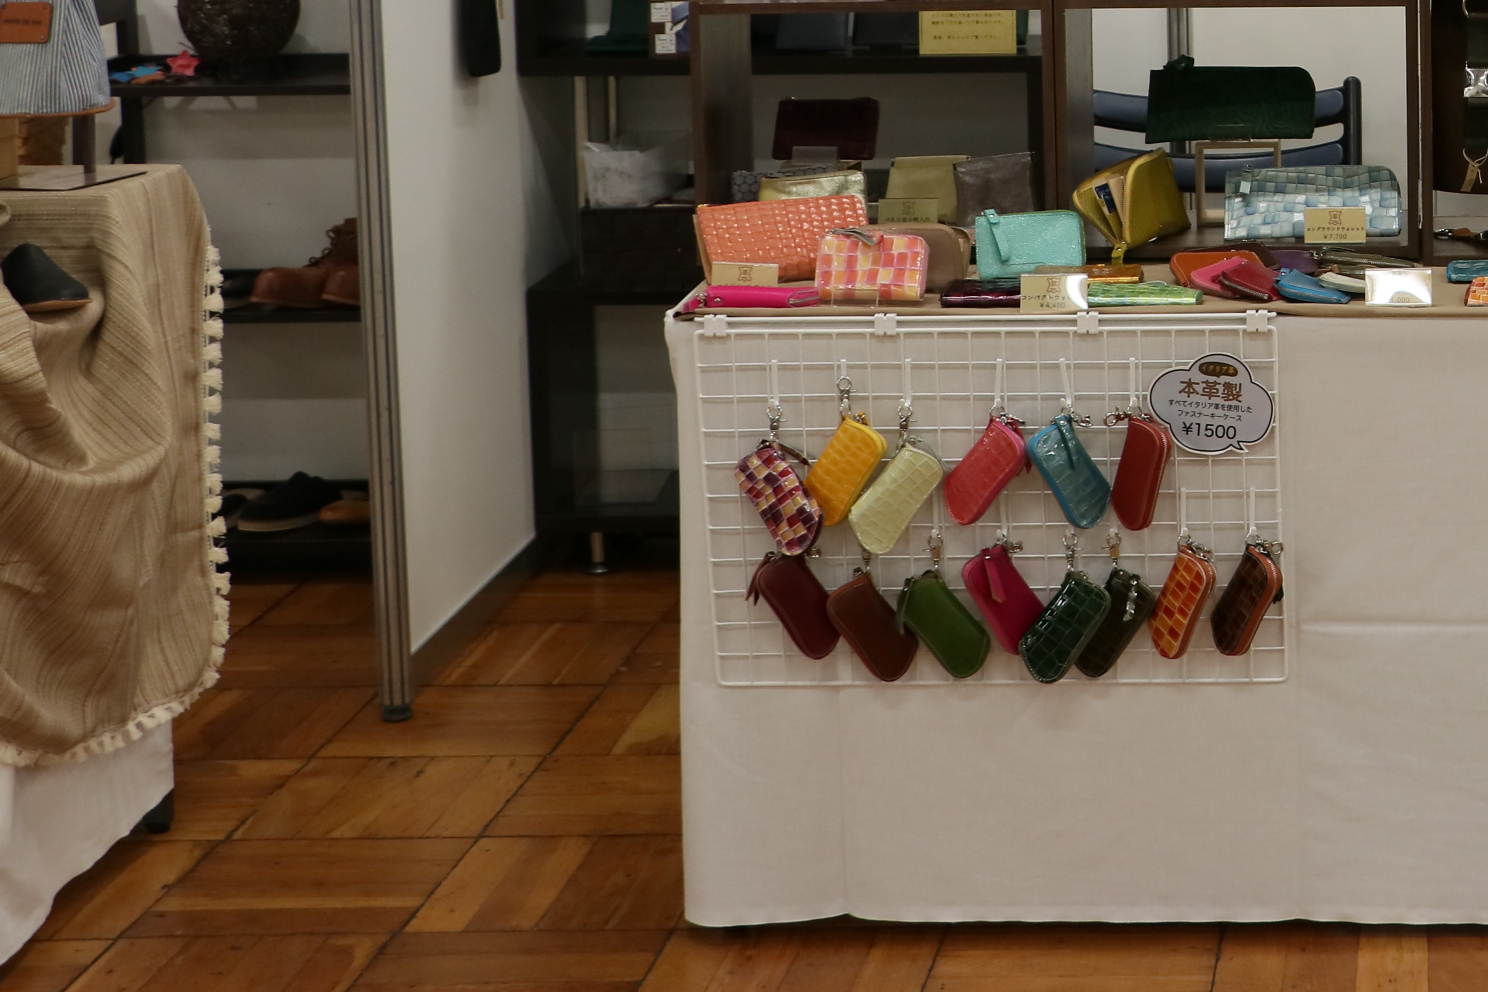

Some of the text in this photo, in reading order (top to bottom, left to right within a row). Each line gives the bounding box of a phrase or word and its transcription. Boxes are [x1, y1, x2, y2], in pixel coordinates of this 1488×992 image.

[1202, 364, 1236, 374] イタリア革
[1179, 378, 1242, 402] 本革製
[1168, 399, 1253, 413] すべてイタリア革を使用した
[1178, 410, 1242, 422] ファスナーキーケース
[1182, 422, 1237, 439] ¥1500
